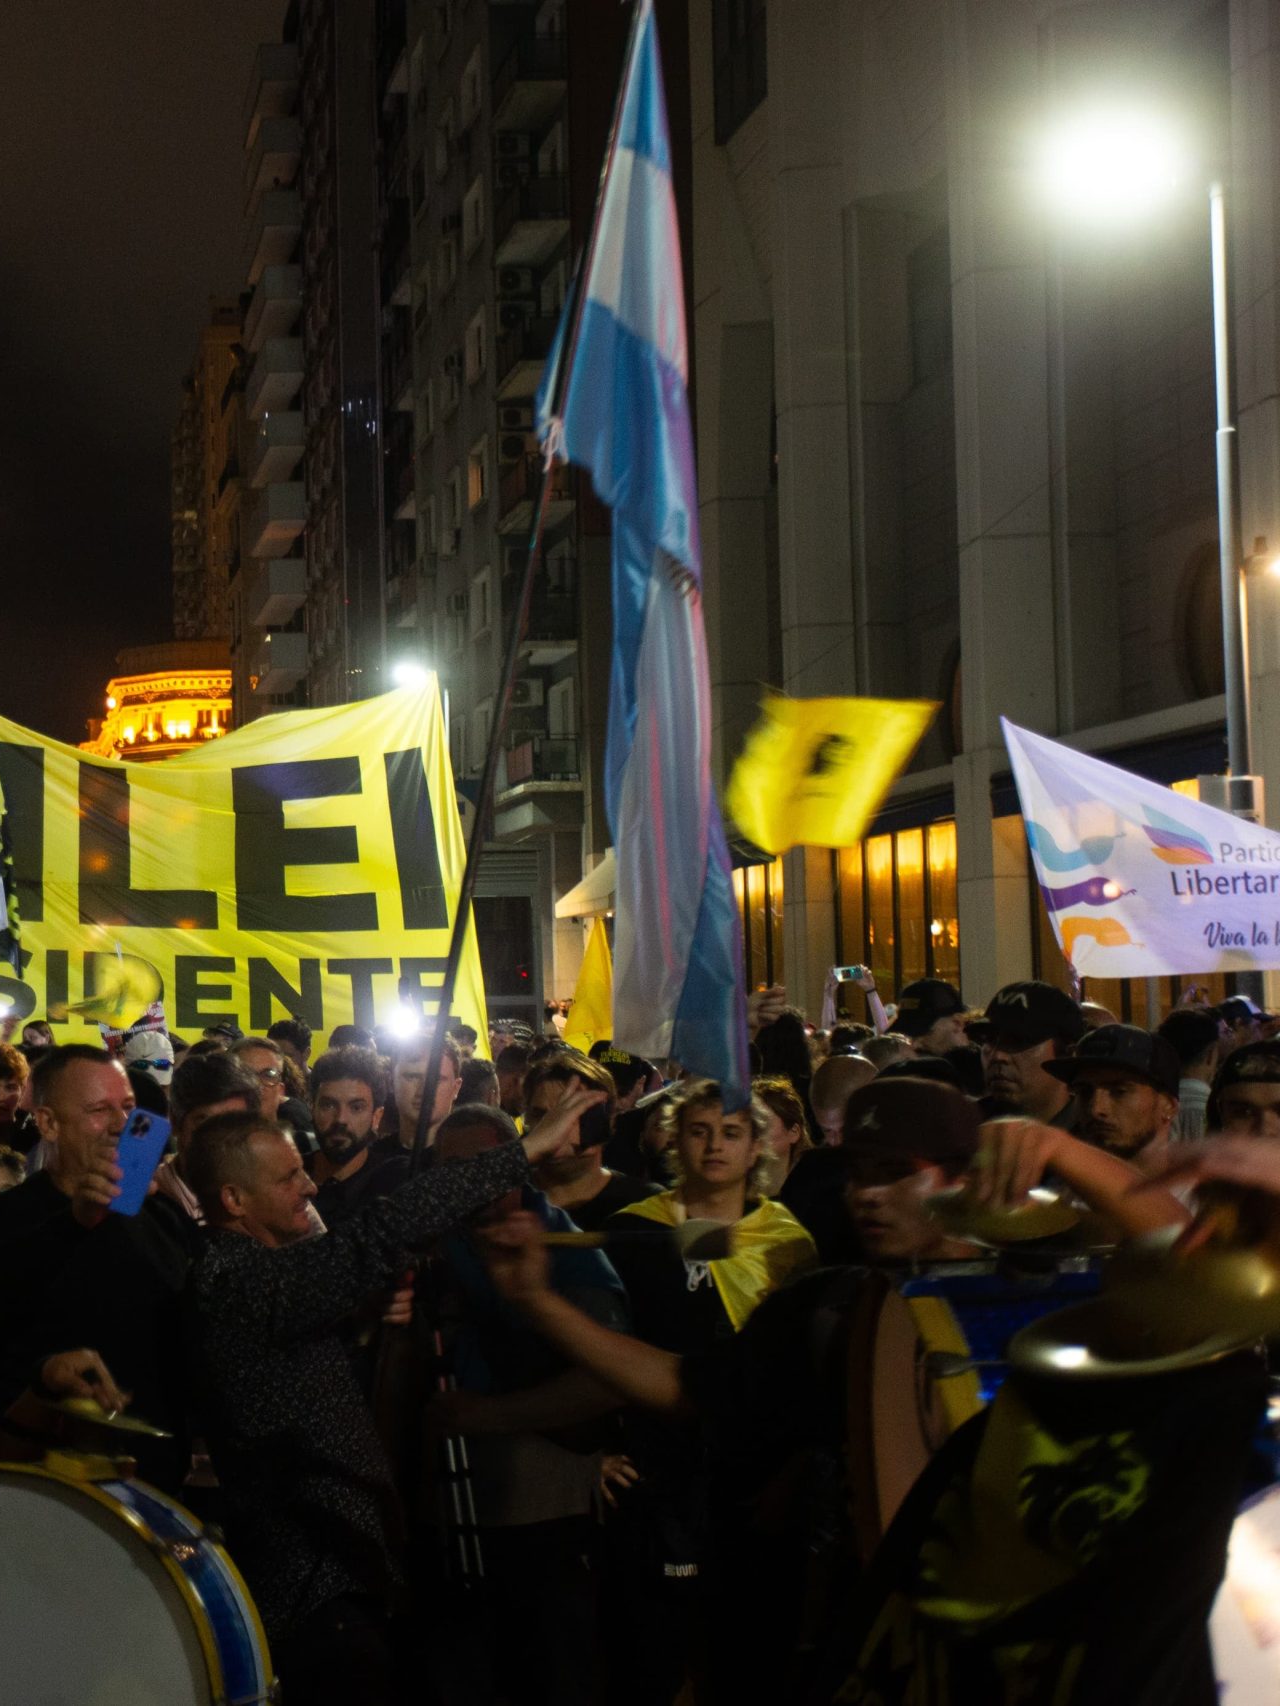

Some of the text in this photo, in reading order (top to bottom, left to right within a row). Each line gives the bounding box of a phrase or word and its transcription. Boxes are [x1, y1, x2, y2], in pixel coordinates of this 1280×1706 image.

[1170, 868, 1280, 896] Libertar
[1203, 921, 1245, 948] Viva
[1251, 920, 1268, 947] la
